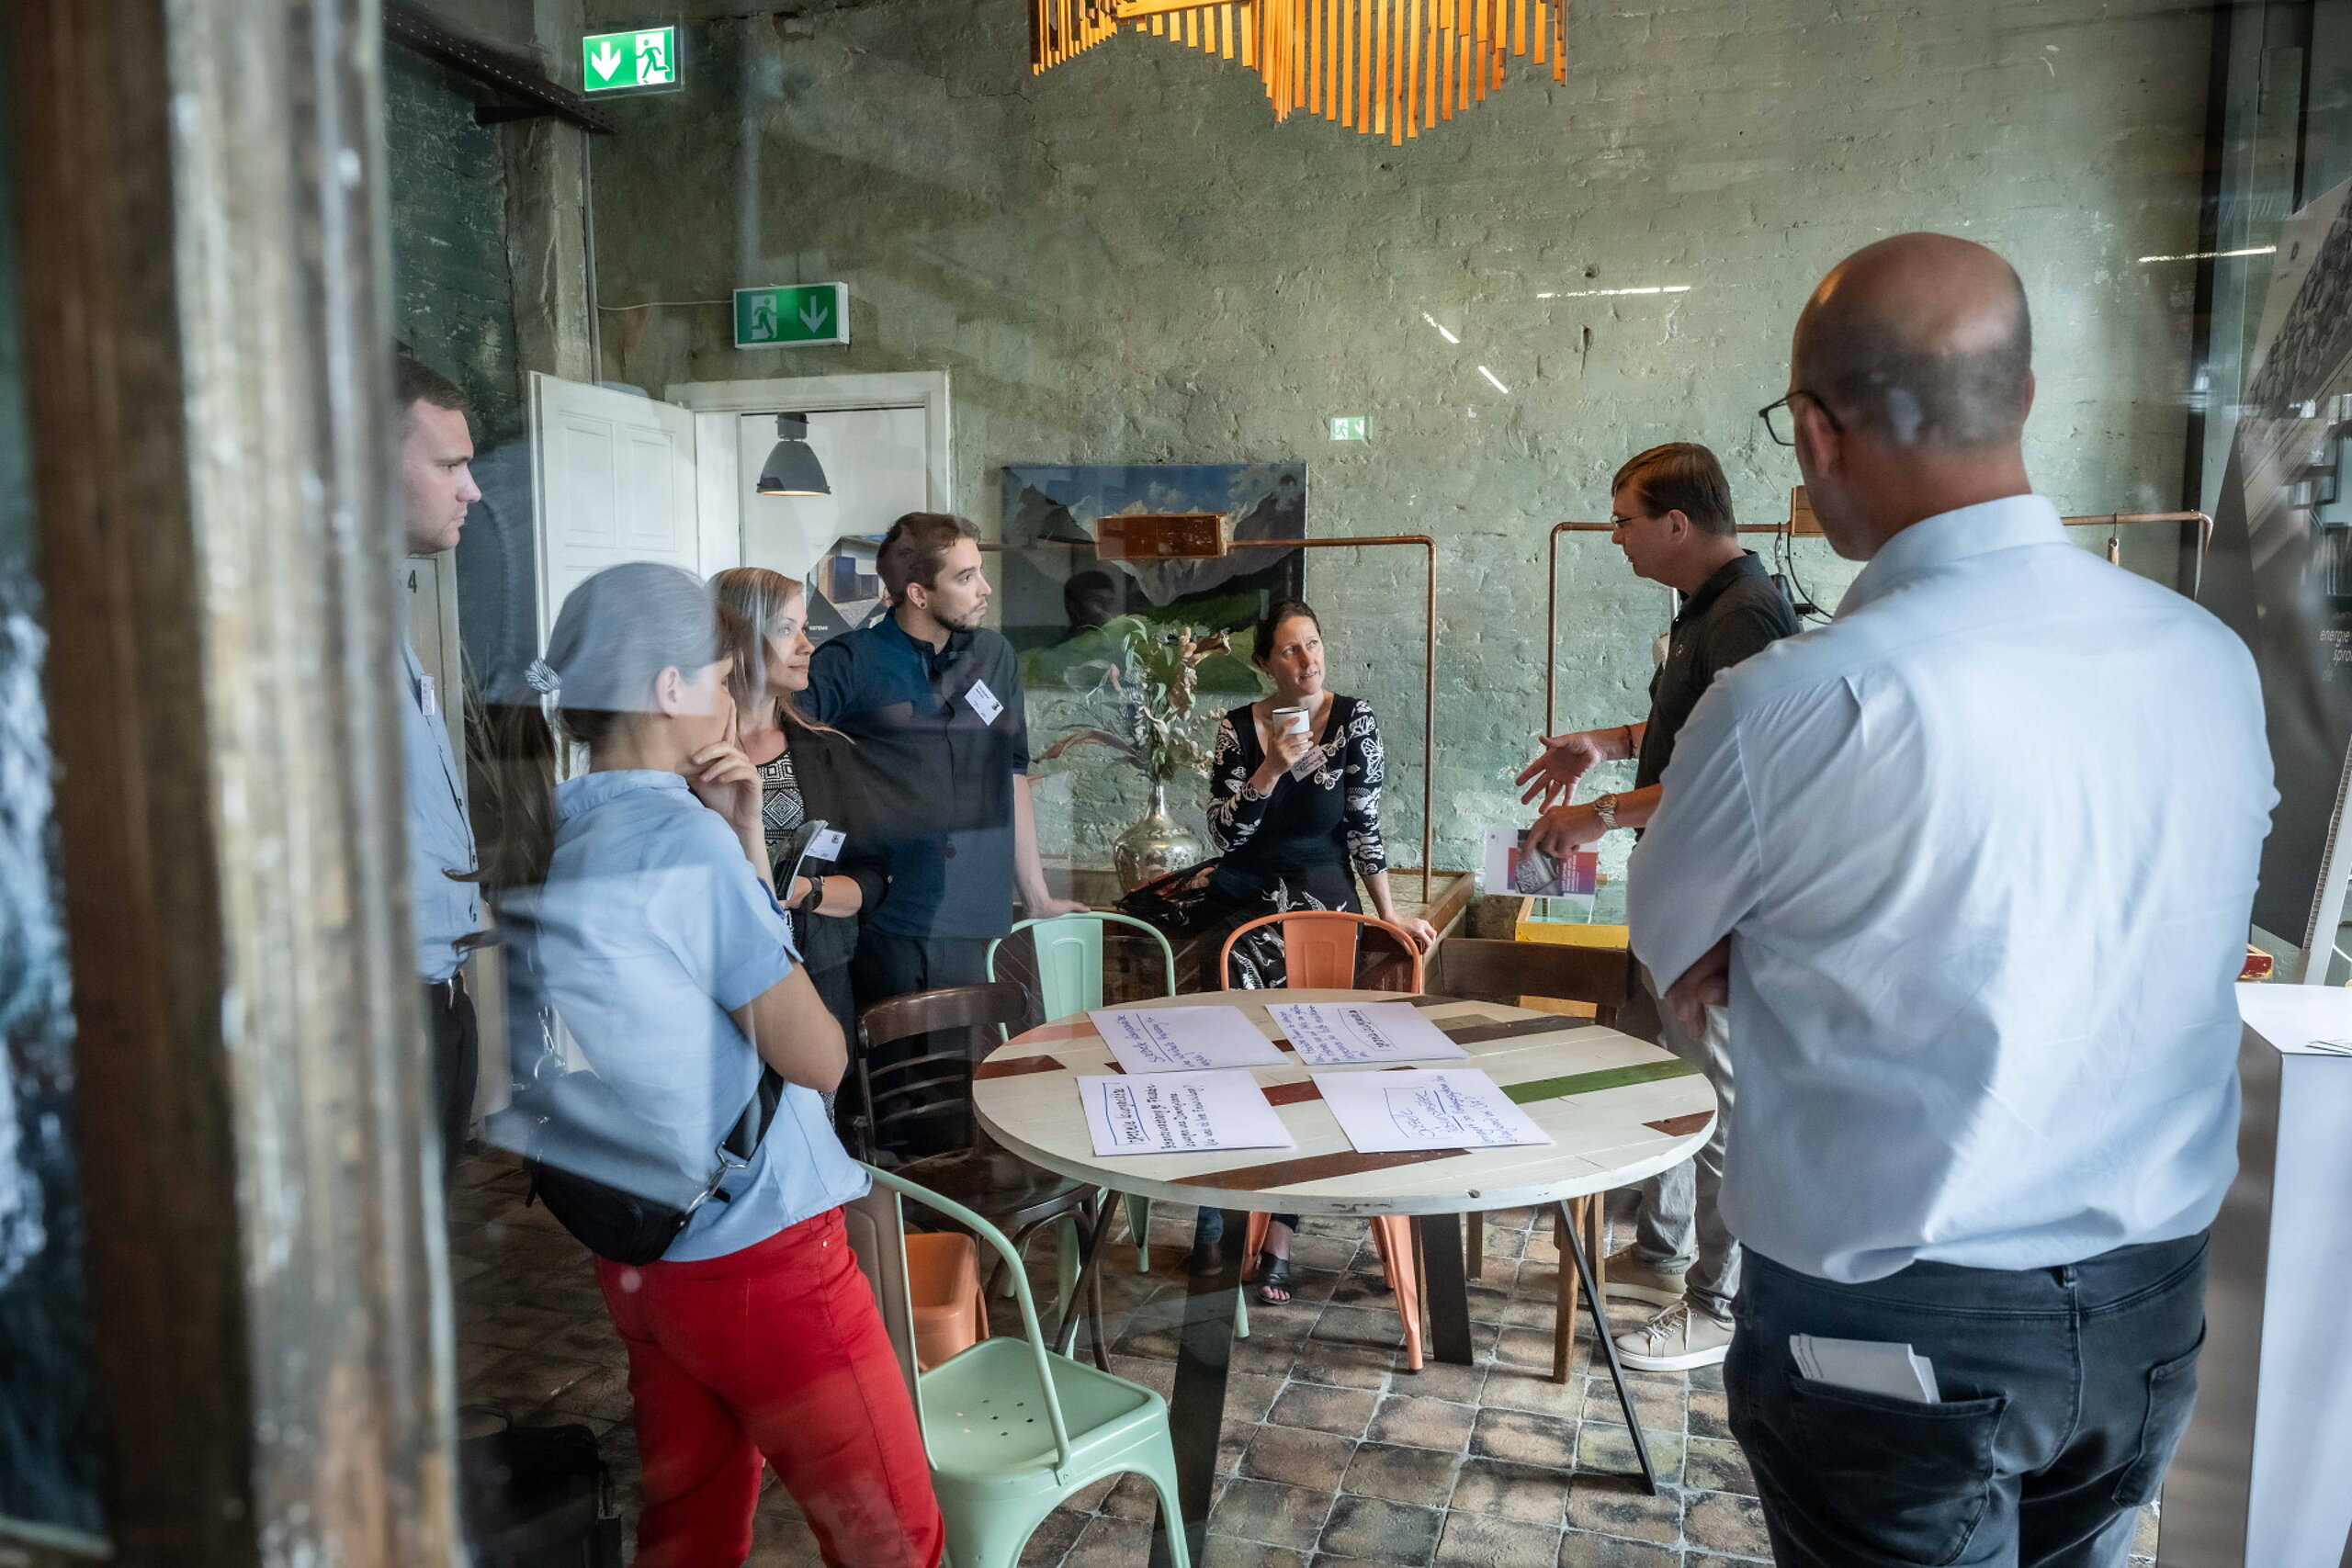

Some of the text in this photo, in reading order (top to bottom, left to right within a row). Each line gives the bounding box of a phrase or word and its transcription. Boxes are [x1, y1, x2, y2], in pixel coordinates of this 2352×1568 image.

[407, 570, 417, 593] 4
[2320, 630, 2350, 648] energie
[2333, 649, 2352, 667] spro
